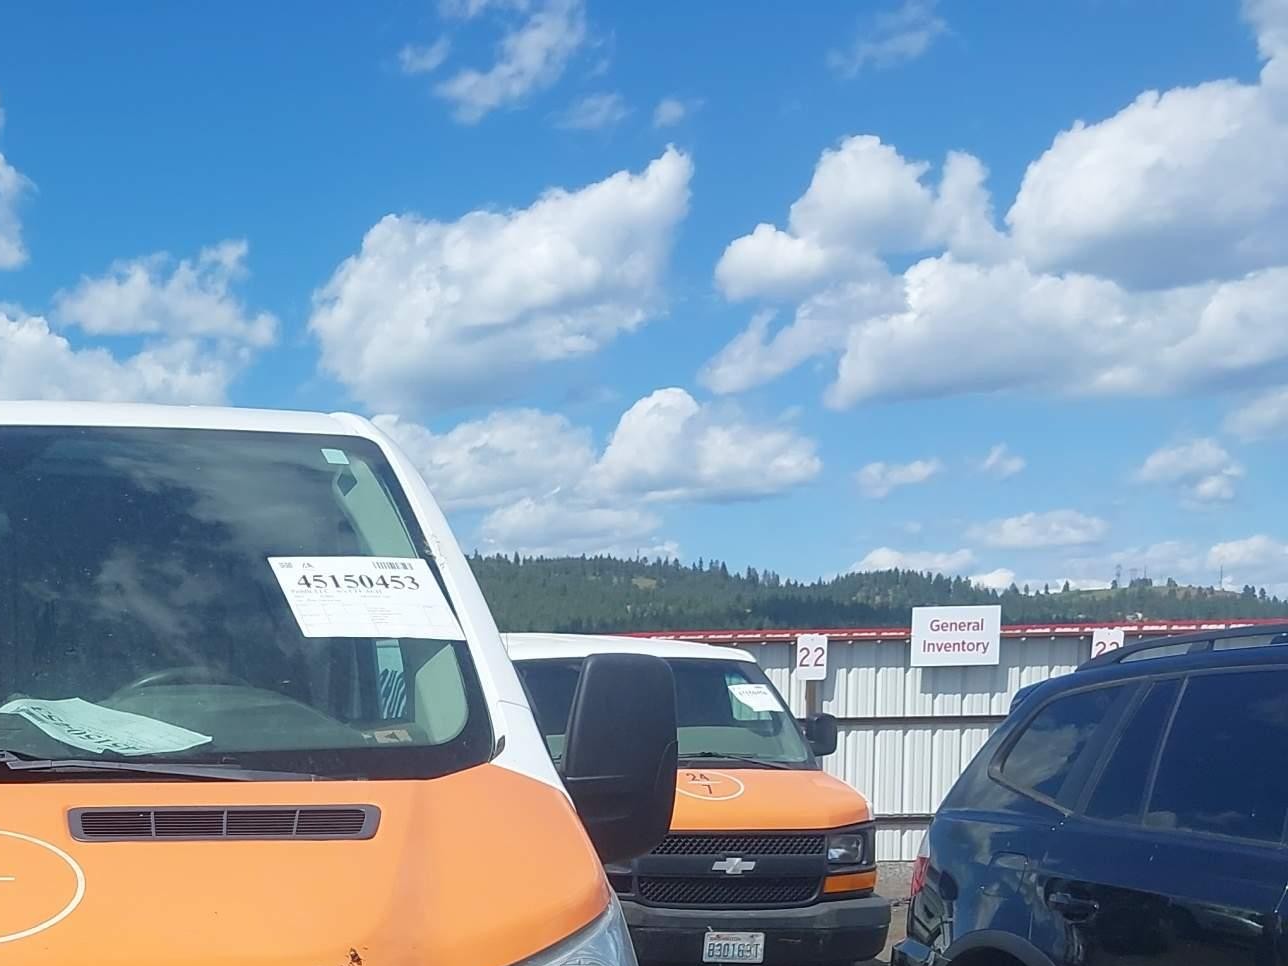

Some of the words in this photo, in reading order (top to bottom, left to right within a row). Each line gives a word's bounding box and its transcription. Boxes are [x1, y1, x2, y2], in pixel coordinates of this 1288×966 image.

[297, 574, 419, 590] 45150453
[929, 617, 984, 632] General
[922, 639, 990, 654] Inventory
[799, 646, 825, 667] 22
[701, 784, 713, 795] 7
